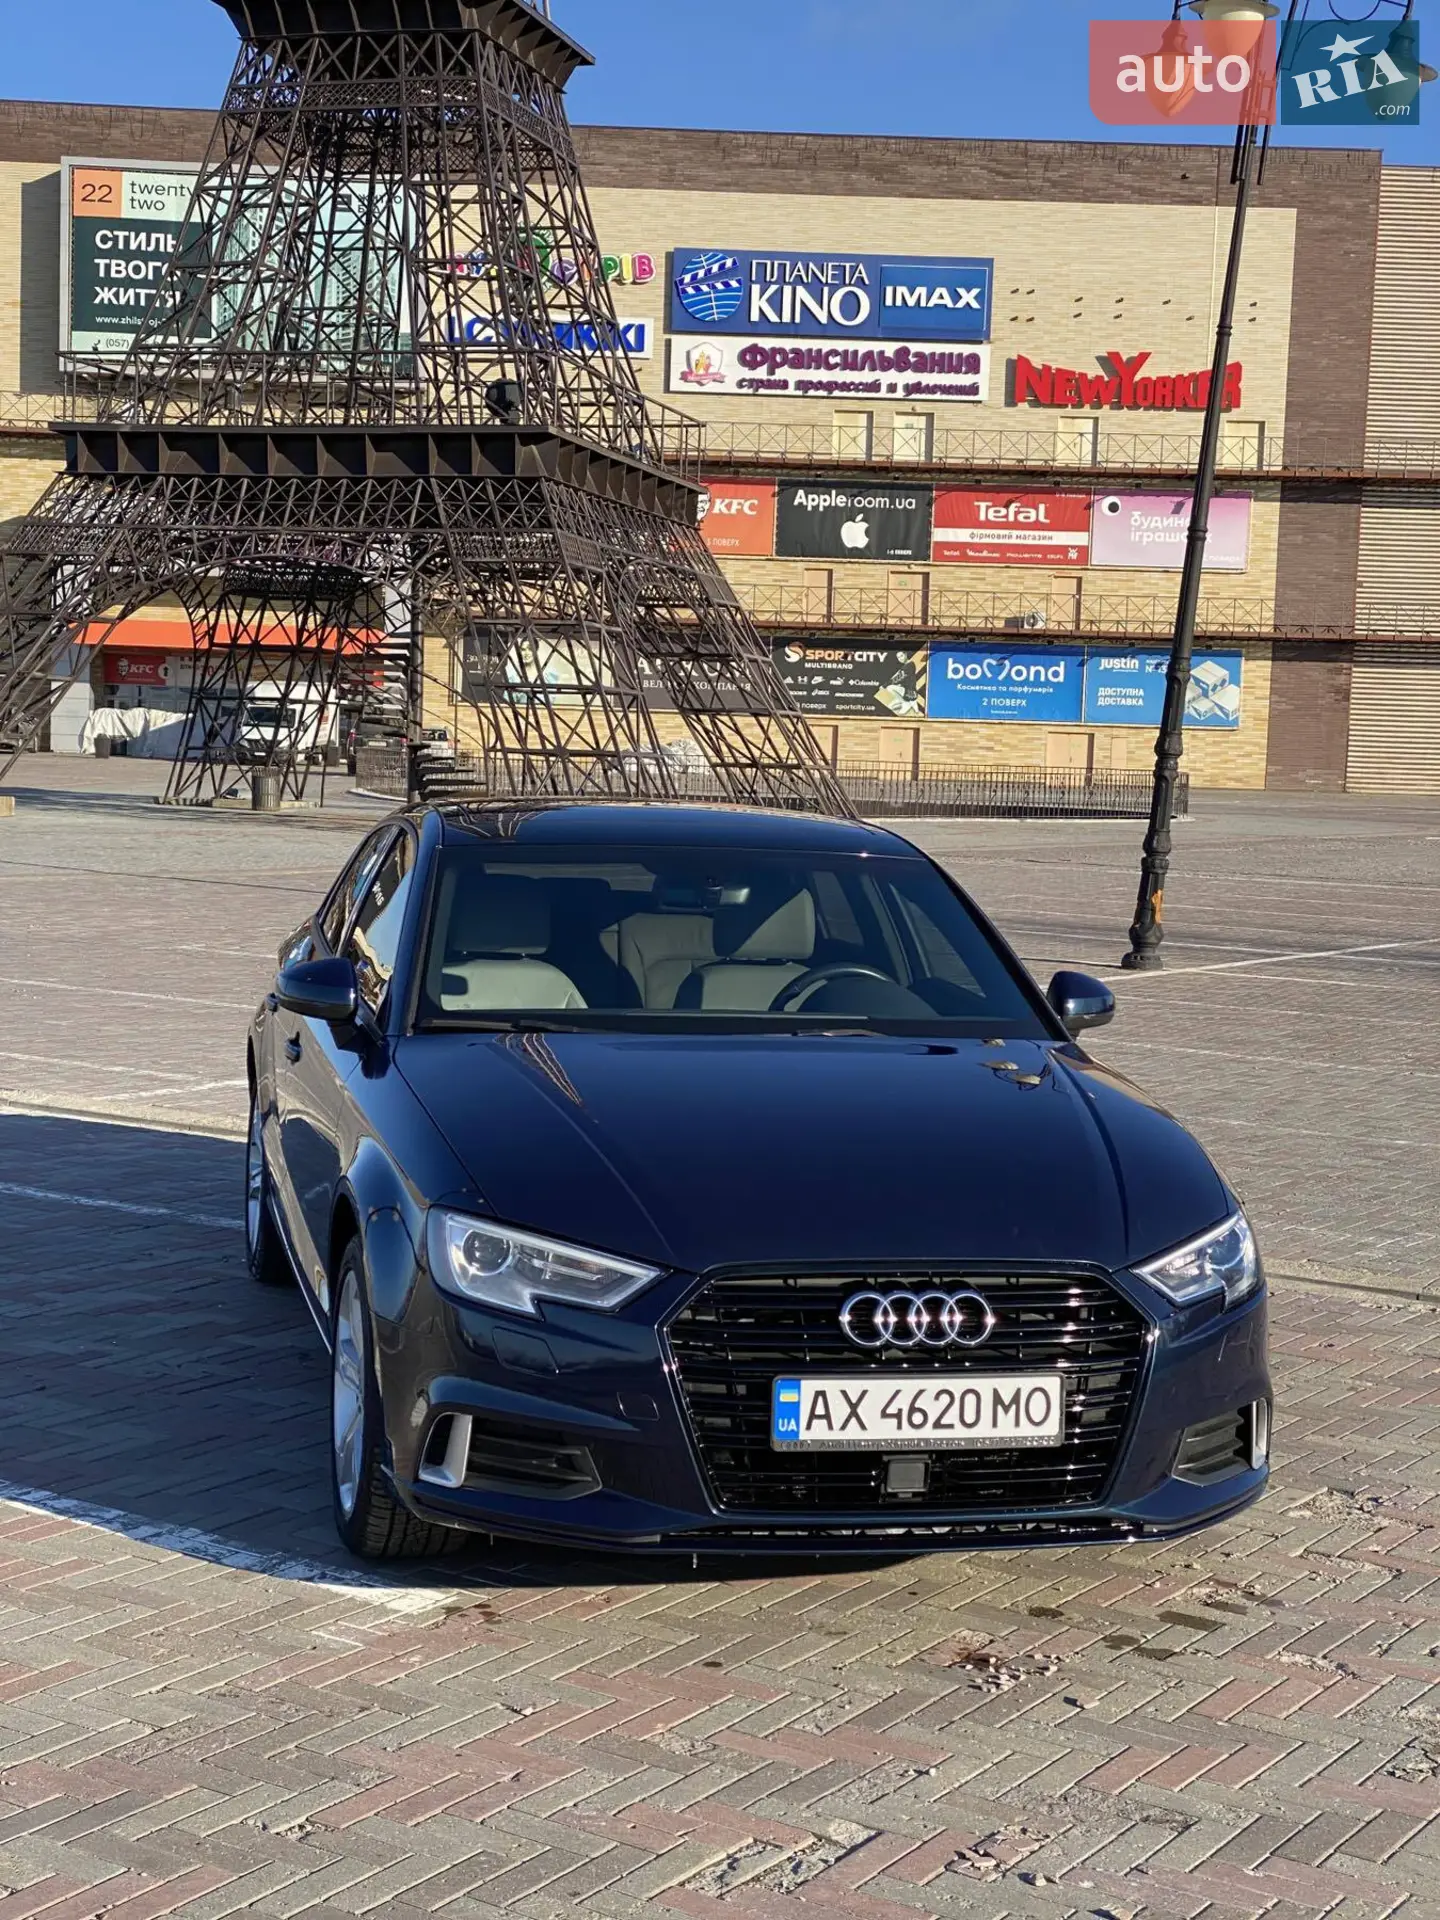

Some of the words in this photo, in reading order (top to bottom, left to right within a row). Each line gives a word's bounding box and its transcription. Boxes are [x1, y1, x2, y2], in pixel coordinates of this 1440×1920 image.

[80, 183, 113, 203] 22
[129, 195, 165, 211] two
[95, 229, 183, 253] СТИЛЬ
[93, 286, 181, 308] ЖИТТЯ
[749, 284, 871, 327] KINO
[884, 286, 981, 309] IMAX
[738, 343, 981, 376] Франсильвания
[737, 378, 789, 392] страна
[795, 379, 882, 396] профессий
[886, 382, 897, 394] и
[904, 382, 980, 397] увлечений
[712, 498, 758, 516] KFC
[793, 489, 916, 512] Appleroom.ua
[974, 501, 1050, 524] Tefal
[969, 530, 1013, 542] фірмовий
[1014, 532, 1053, 542] магазин
[805, 650, 888, 663] SPORTCITY
[129, 664, 154, 674] KFC
[804, 662, 854, 670] MULTIBRAND
[957, 683, 997, 692] Косметика
[1009, 685, 1054, 694] парфумерія
[1098, 687, 1144, 697] ДОСТУПНА
[835, 703, 876, 712] sportcity.ua
[982, 698, 988, 706] 2
[991, 698, 1027, 707] ПОВЕРХ
[1097, 697, 1144, 707] ДОСТАВКА
[805, 1389, 869, 1432] AX
[880, 1388, 982, 1430] 4620
[992, 1386, 1052, 1428] MO
[778, 1418, 798, 1432] UA
